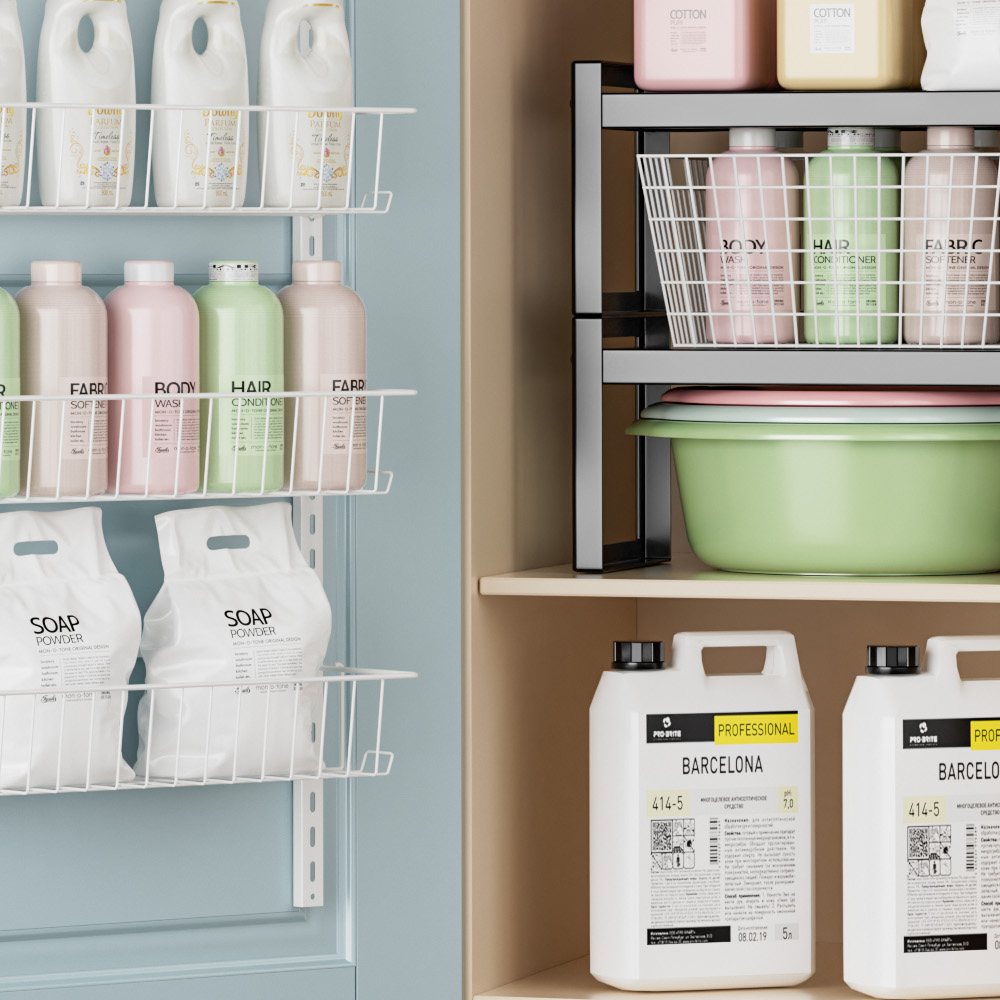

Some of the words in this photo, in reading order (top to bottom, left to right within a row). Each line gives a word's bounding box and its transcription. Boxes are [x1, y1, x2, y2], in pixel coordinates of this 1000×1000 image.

[670, 9, 707, 20] COTTON
[814, 8, 850, 18] COTTON
[232, 380, 272, 393] HAIR
[224, 608, 272, 627] SOAP
[30, 614, 80, 634] SOAP
[230, 626, 276, 638] POWDER
[36, 634, 84, 646] POWDER
[653, 730, 682, 738] PRO-BRITE
[718, 722, 795, 736] PROFESSIONAL
[682, 755, 764, 775] BARCELONA
[652, 795, 684, 811] 414-5
[784, 798, 794, 810] 7,0
[908, 802, 940, 817] 414-5
[738, 932, 768, 942] 08.02.19
